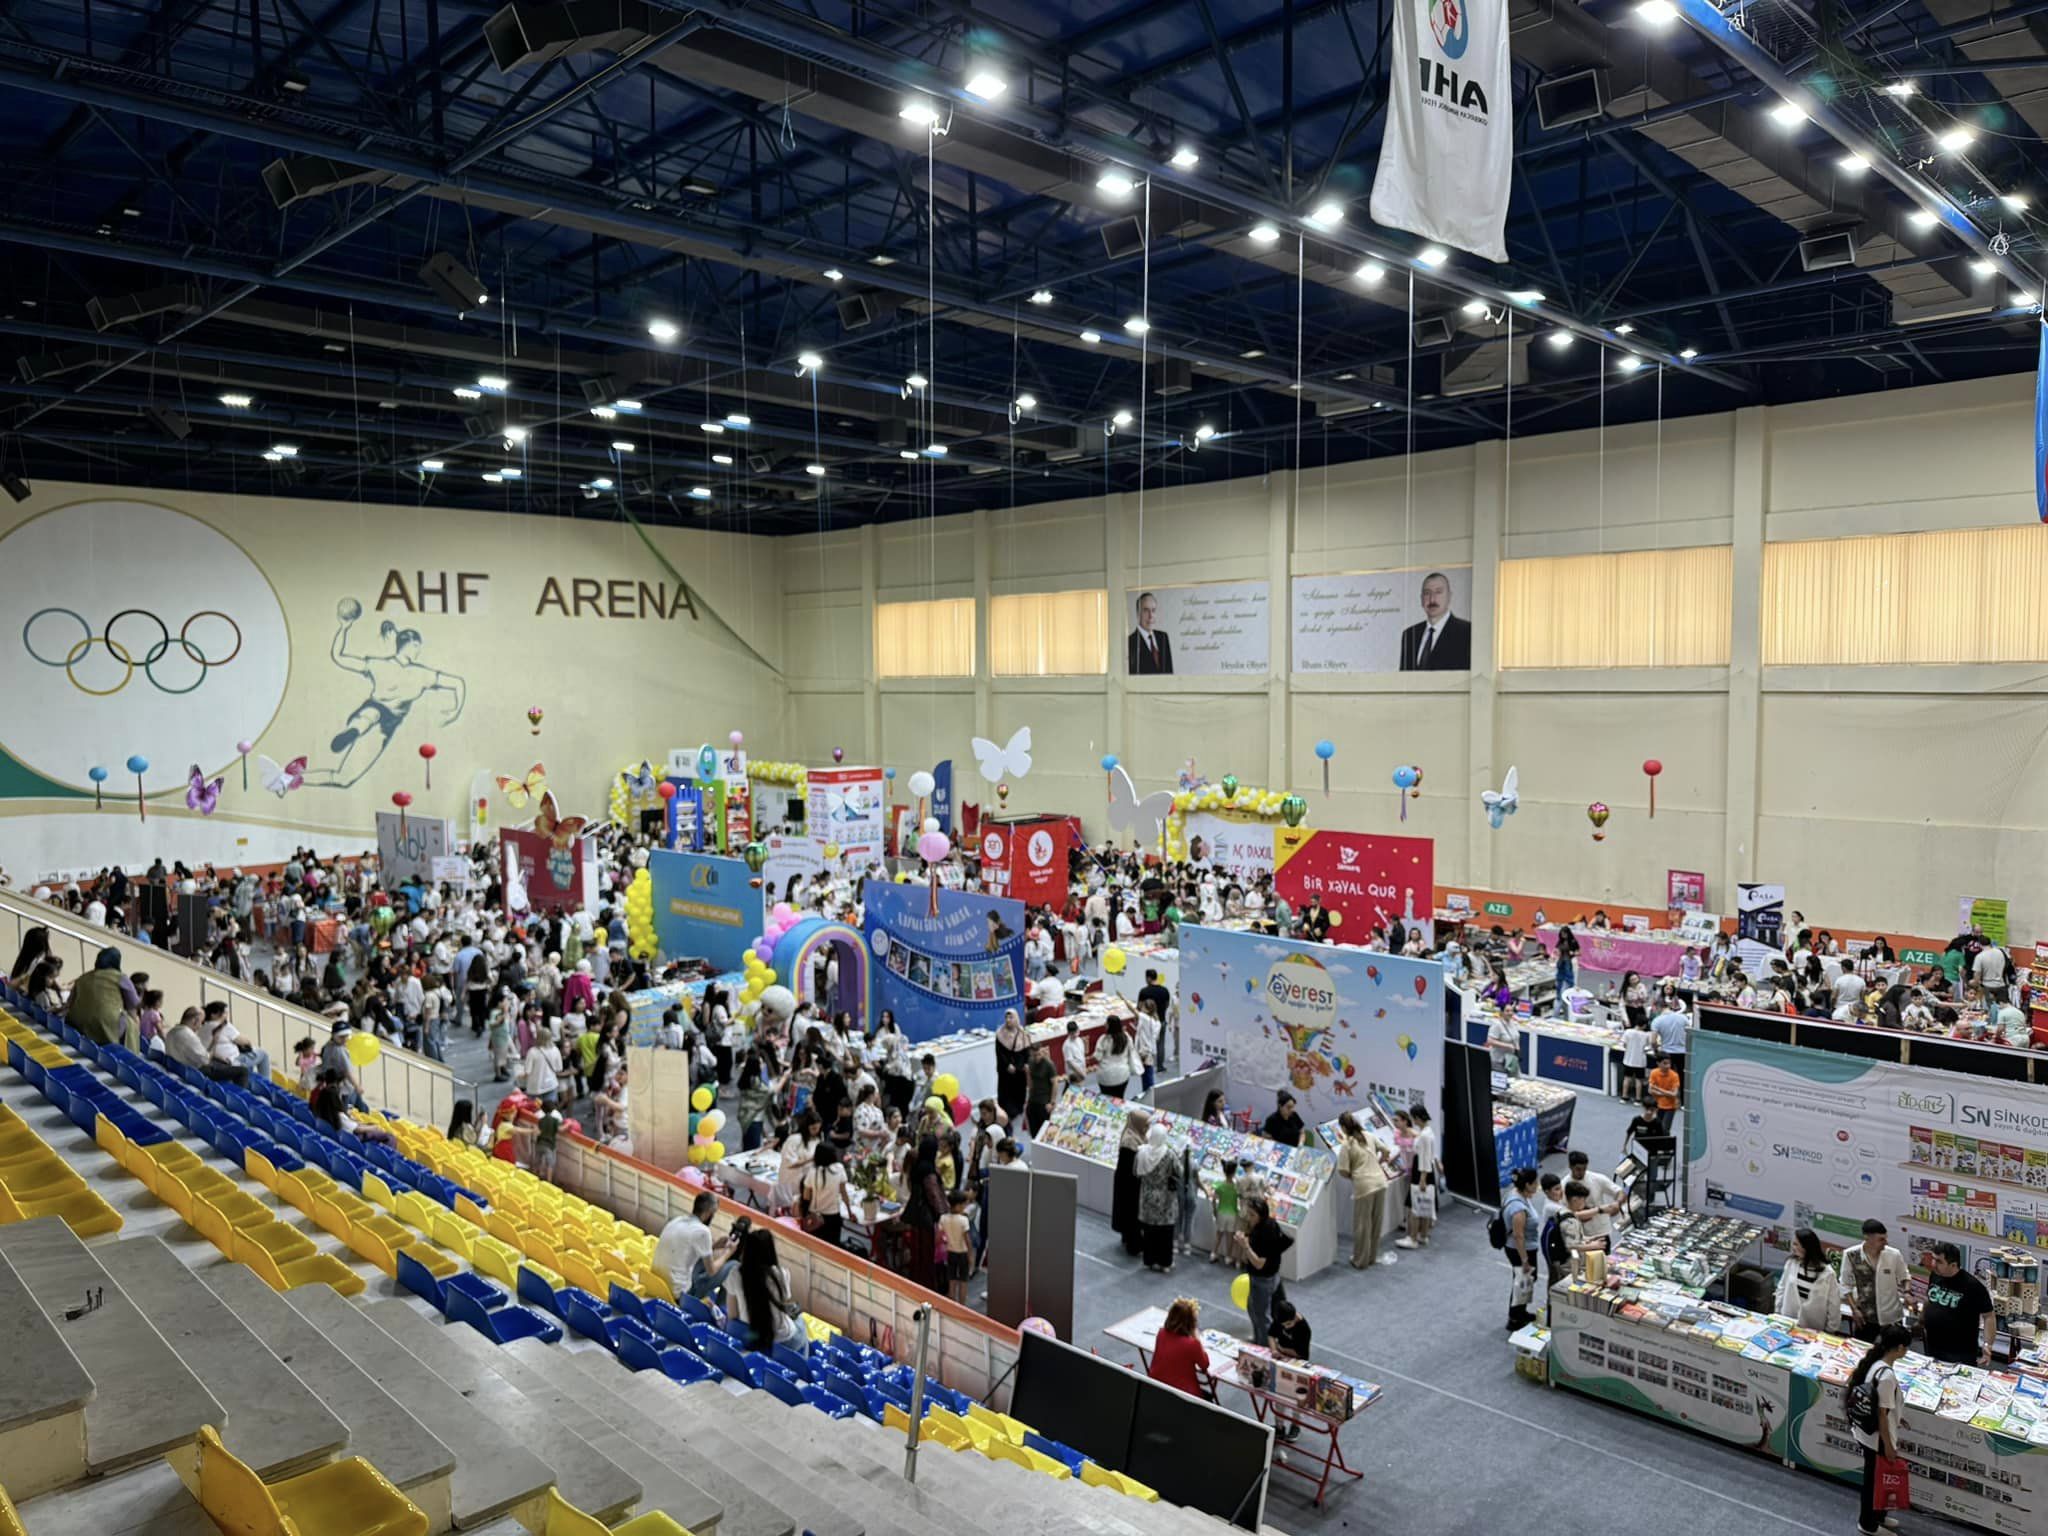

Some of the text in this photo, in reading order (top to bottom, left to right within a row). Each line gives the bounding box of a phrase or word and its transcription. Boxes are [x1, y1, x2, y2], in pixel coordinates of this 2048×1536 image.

[375, 569, 699, 621] AHF ARENA
[1367, 883, 1397, 899] QUR
[1487, 903, 1509, 914] AZE
[1905, 951, 1934, 964] AZE
